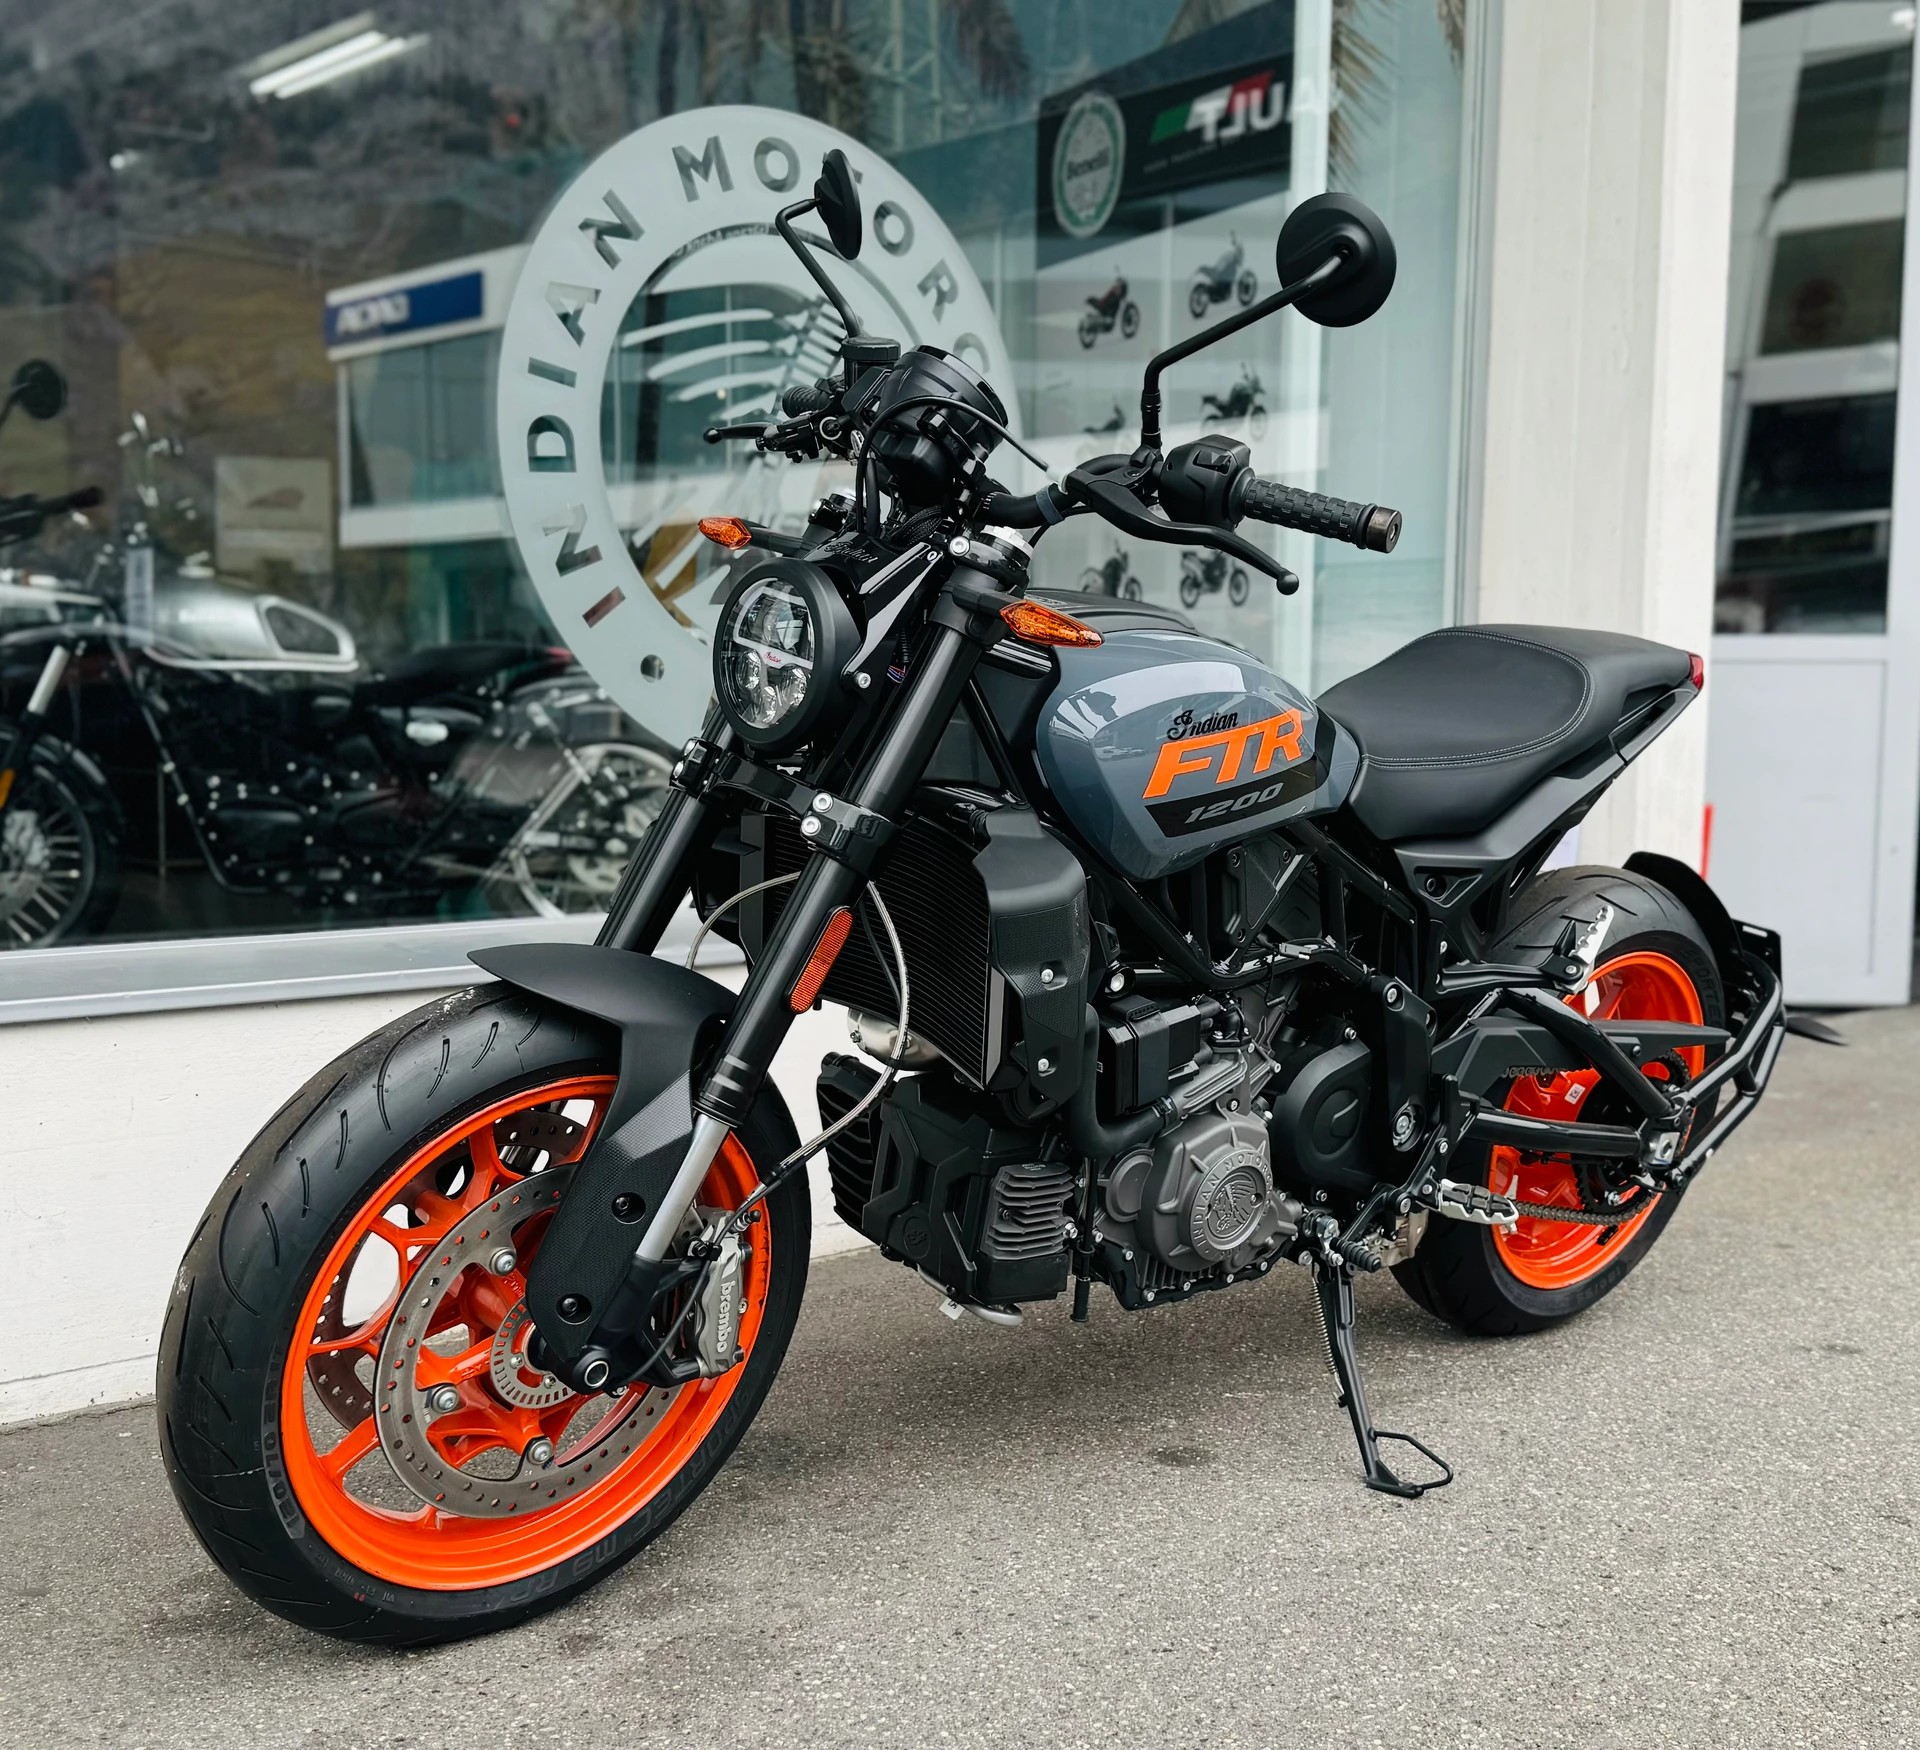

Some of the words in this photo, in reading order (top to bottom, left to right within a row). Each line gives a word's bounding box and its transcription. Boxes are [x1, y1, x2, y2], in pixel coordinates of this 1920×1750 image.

[527, 189, 645, 629] INDIAN
[672, 135, 991, 375] MOORC
[1142, 708, 1304, 799] FTR
[1166, 708, 1239, 741] Indian
[1183, 782, 1285, 824] 1200
[1193, 1173, 1222, 1248] INDIAN
[716, 1280, 736, 1354] brembo
